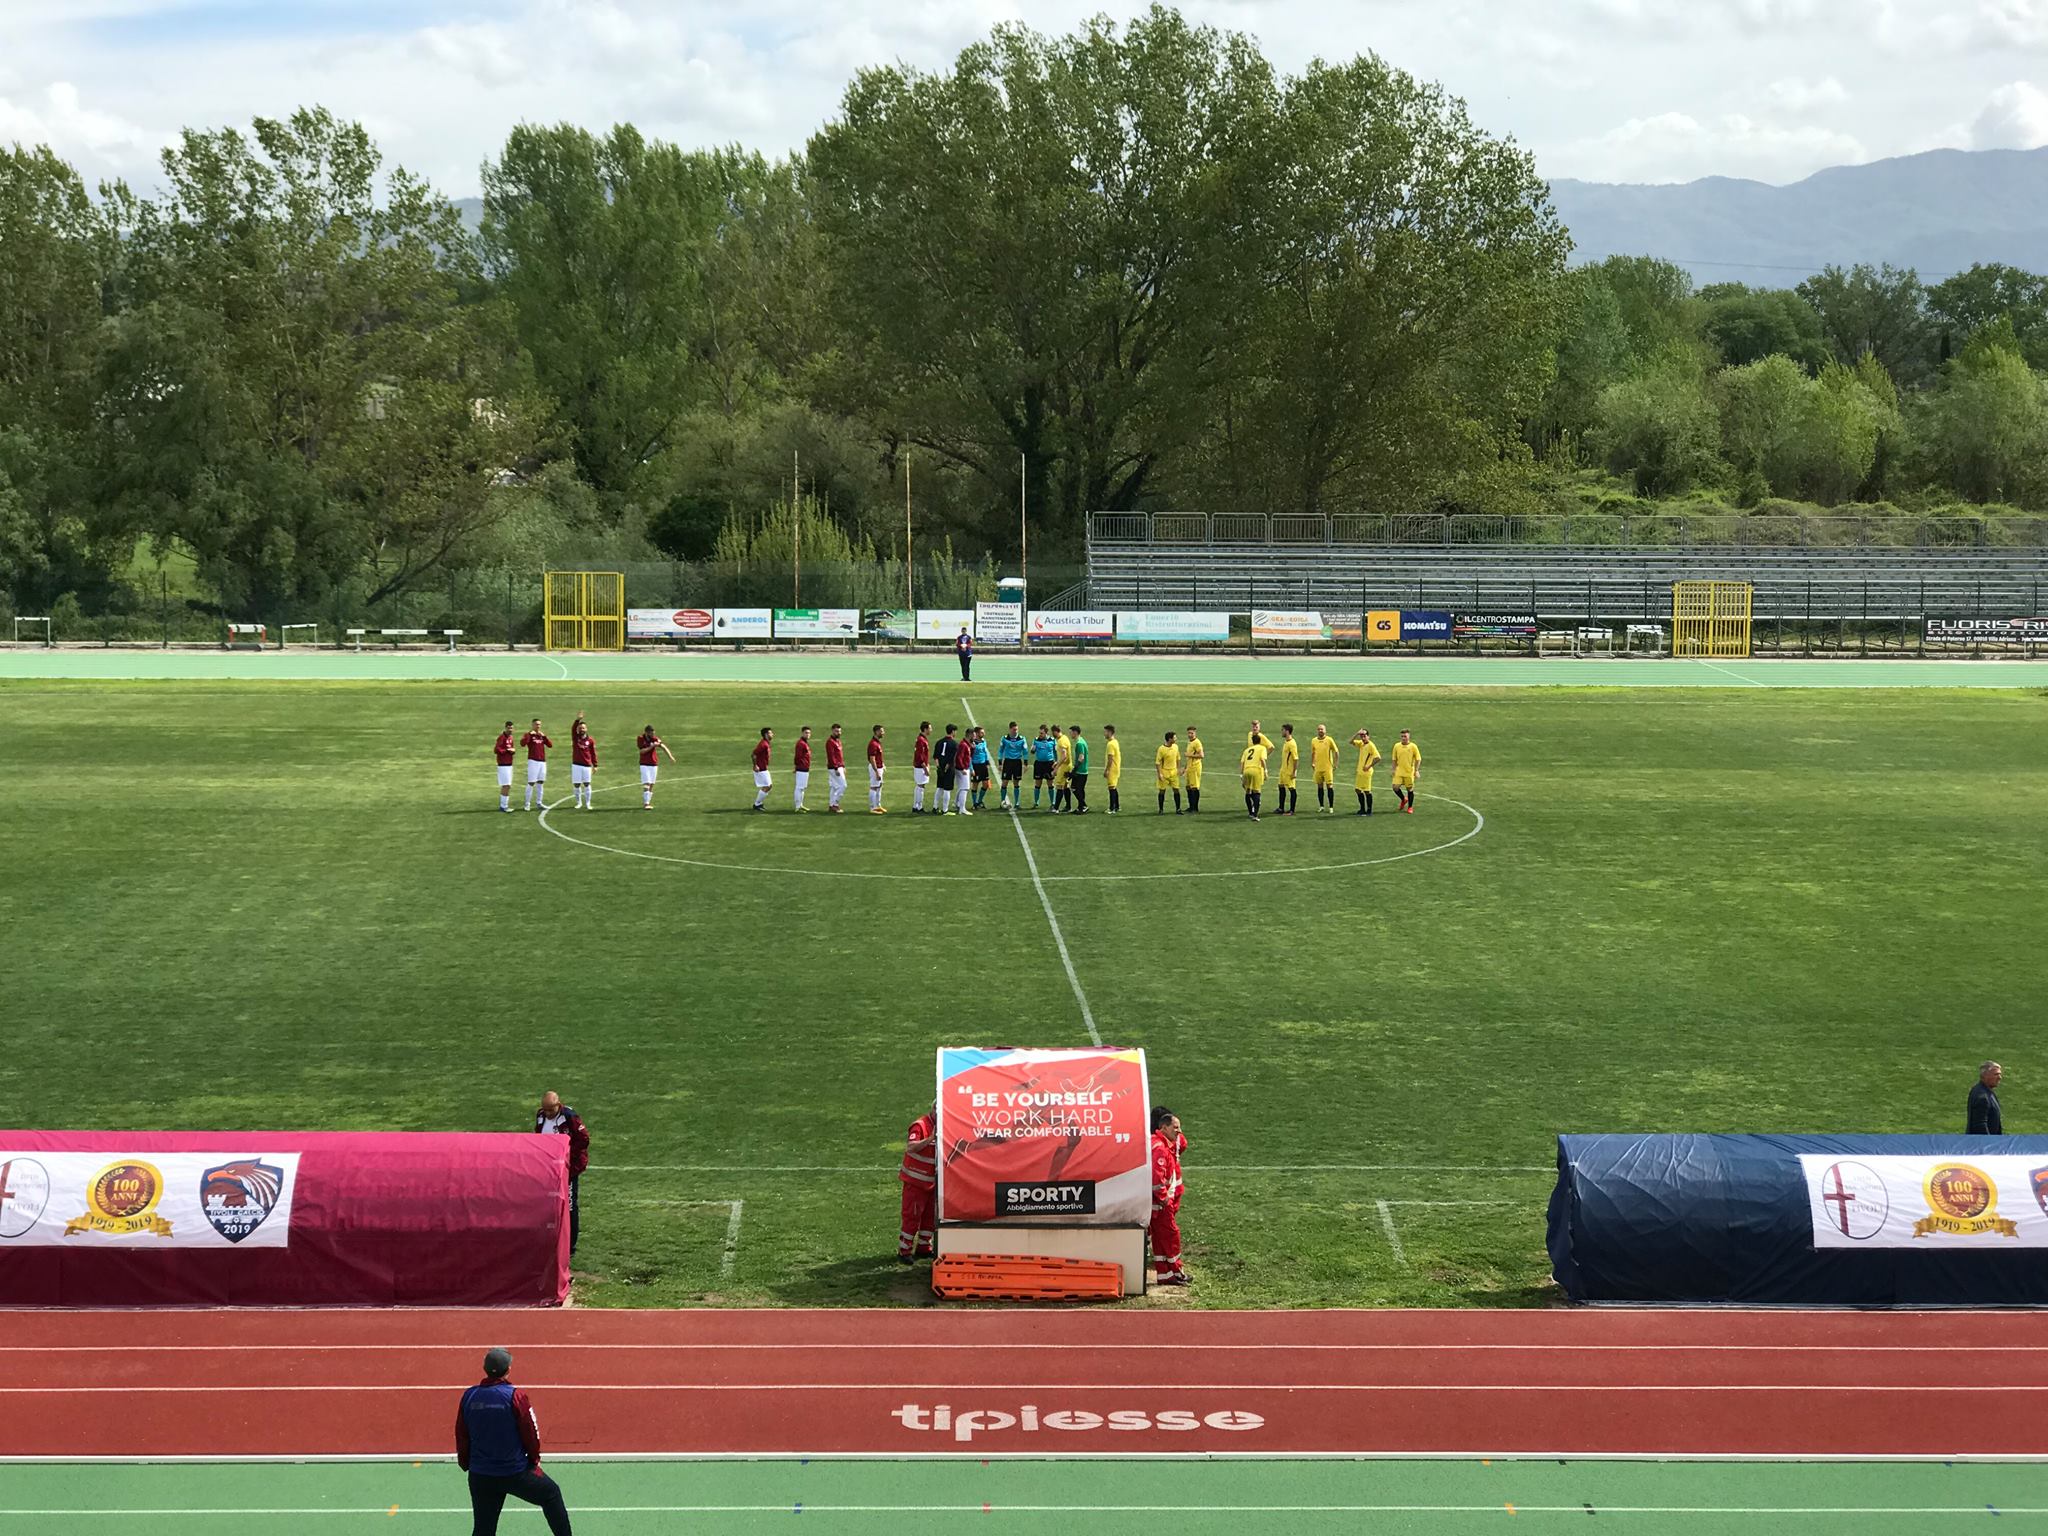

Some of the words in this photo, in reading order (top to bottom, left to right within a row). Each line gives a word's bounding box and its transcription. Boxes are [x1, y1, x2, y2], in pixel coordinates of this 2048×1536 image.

[1044, 616, 1081, 625] Acustica
[1083, 616, 1105, 625] Tibur
[1376, 620, 1391, 631] GS
[1403, 620, 1447, 630] KOMATSU
[1247, 749, 1255, 761] 2
[972, 1093, 999, 1107] BE
[1007, 1091, 1113, 1107] YOURSELF
[972, 1109, 1042, 1126] WORK
[1050, 1108, 1113, 1125] HARD
[973, 1128, 1012, 1138] WEAR
[1016, 1126, 1112, 1138] COMFORTABLE
[113, 1179, 140, 1191] 100
[1946, 1180, 1973, 1193] 100
[111, 1193, 138, 1201] ANNI
[1007, 1186, 1084, 1203] SPORTY
[1949, 1194, 1974, 1203] ANNI
[1006, 1203, 1056, 1212] Abbigliamento
[1056, 1202, 1084, 1210] sportivo
[125, 1216, 152, 1230] 2019
[224, 1224, 251, 1234] 2019
[1935, 1217, 1960, 1232] 1919
[1971, 1217, 1996, 1232] 2019
[890, 1404, 1265, 1442] tipiesse
